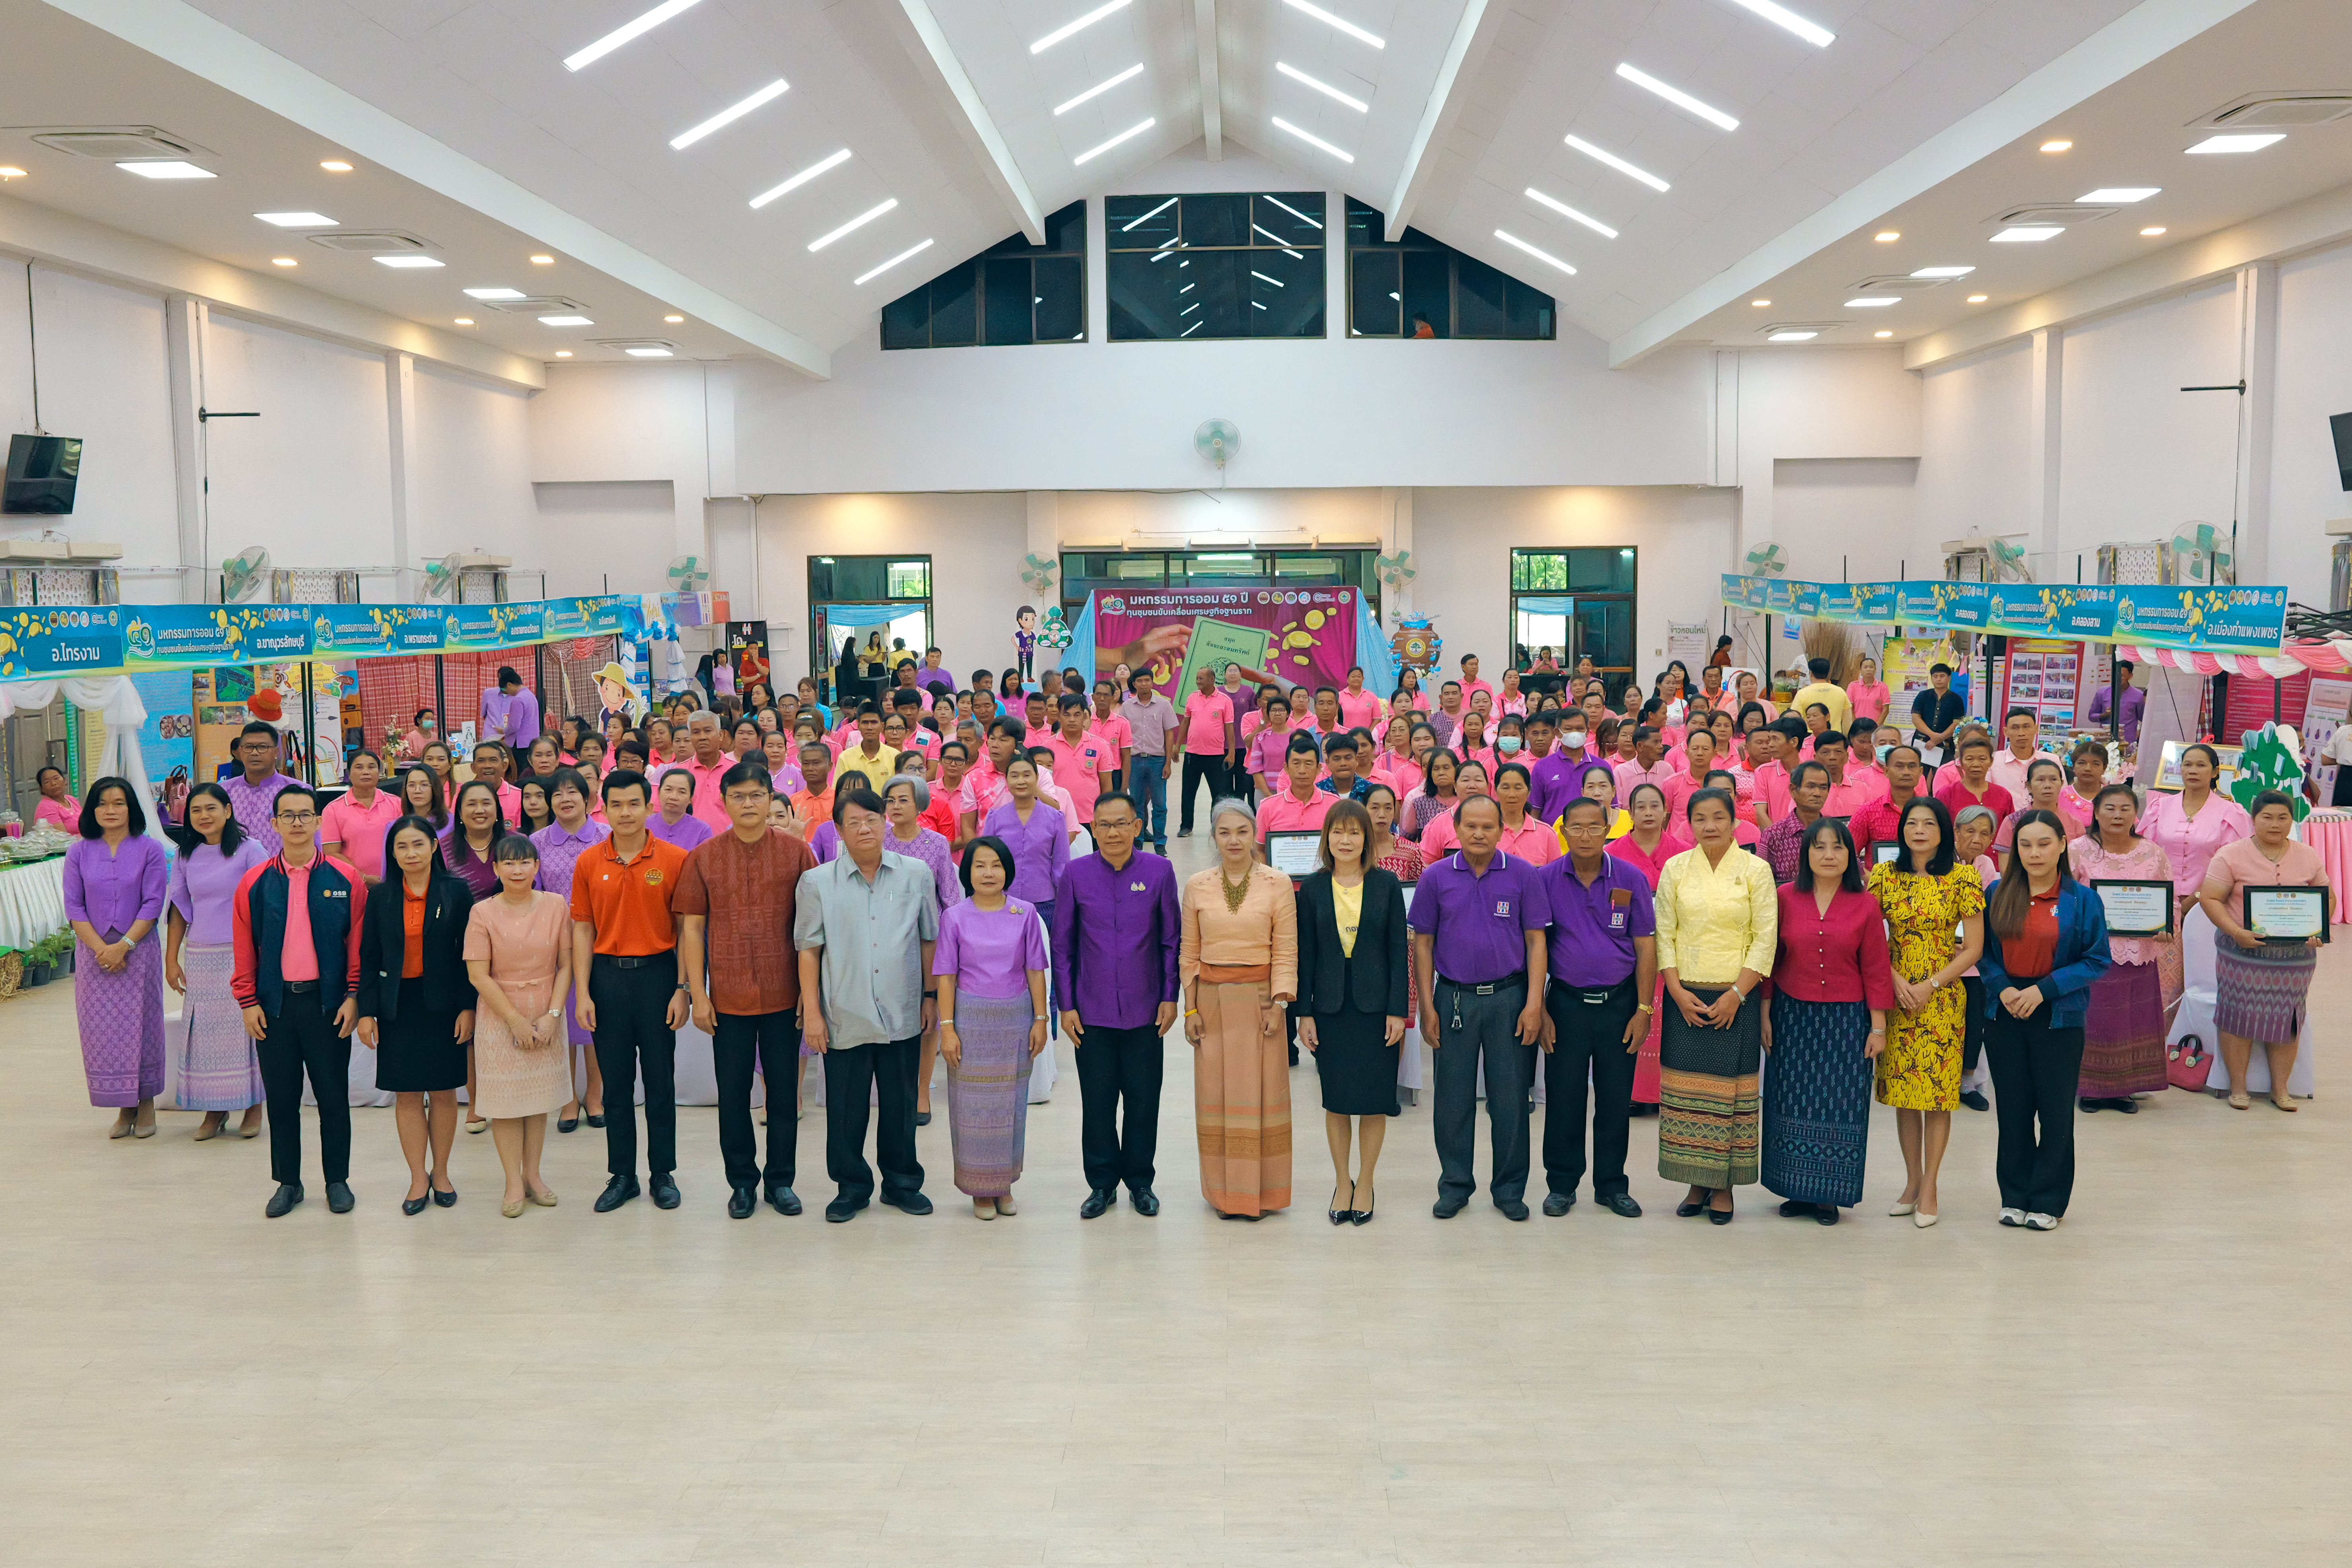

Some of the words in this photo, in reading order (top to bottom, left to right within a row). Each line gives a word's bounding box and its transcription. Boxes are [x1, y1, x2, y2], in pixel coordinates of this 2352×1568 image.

[1130, 595, 1219, 605] มหกรรมการออม
[1222, 594, 1237, 605] ๕๑
[1240, 592, 1248, 603] ปี
[1127, 606, 1252, 618] ทุนชุมชนขับเคลื่อนเศรษฐกิจฐานราก
[1955, 609, 1978, 622] อ.คลองขลุง
[2137, 607, 2179, 618] มหกรรมการออม
[2072, 616, 2100, 627] อ.คลองลาน
[158, 628, 214, 639] มหกรรมการออม
[1670, 625, 1706, 633] ข้าวหอมใหม่
[2208, 620, 2278, 639] อ.เมืองกำแพงเพชร
[257, 634, 304, 651] อ.ขาณุวรลักษบุรี
[404, 632, 437, 643] อ.พรานกระต่าย
[52, 643, 99, 662] อ.ไทรงาม
[1206, 641, 1250, 655] สัจจะสะสมทรัพย์
